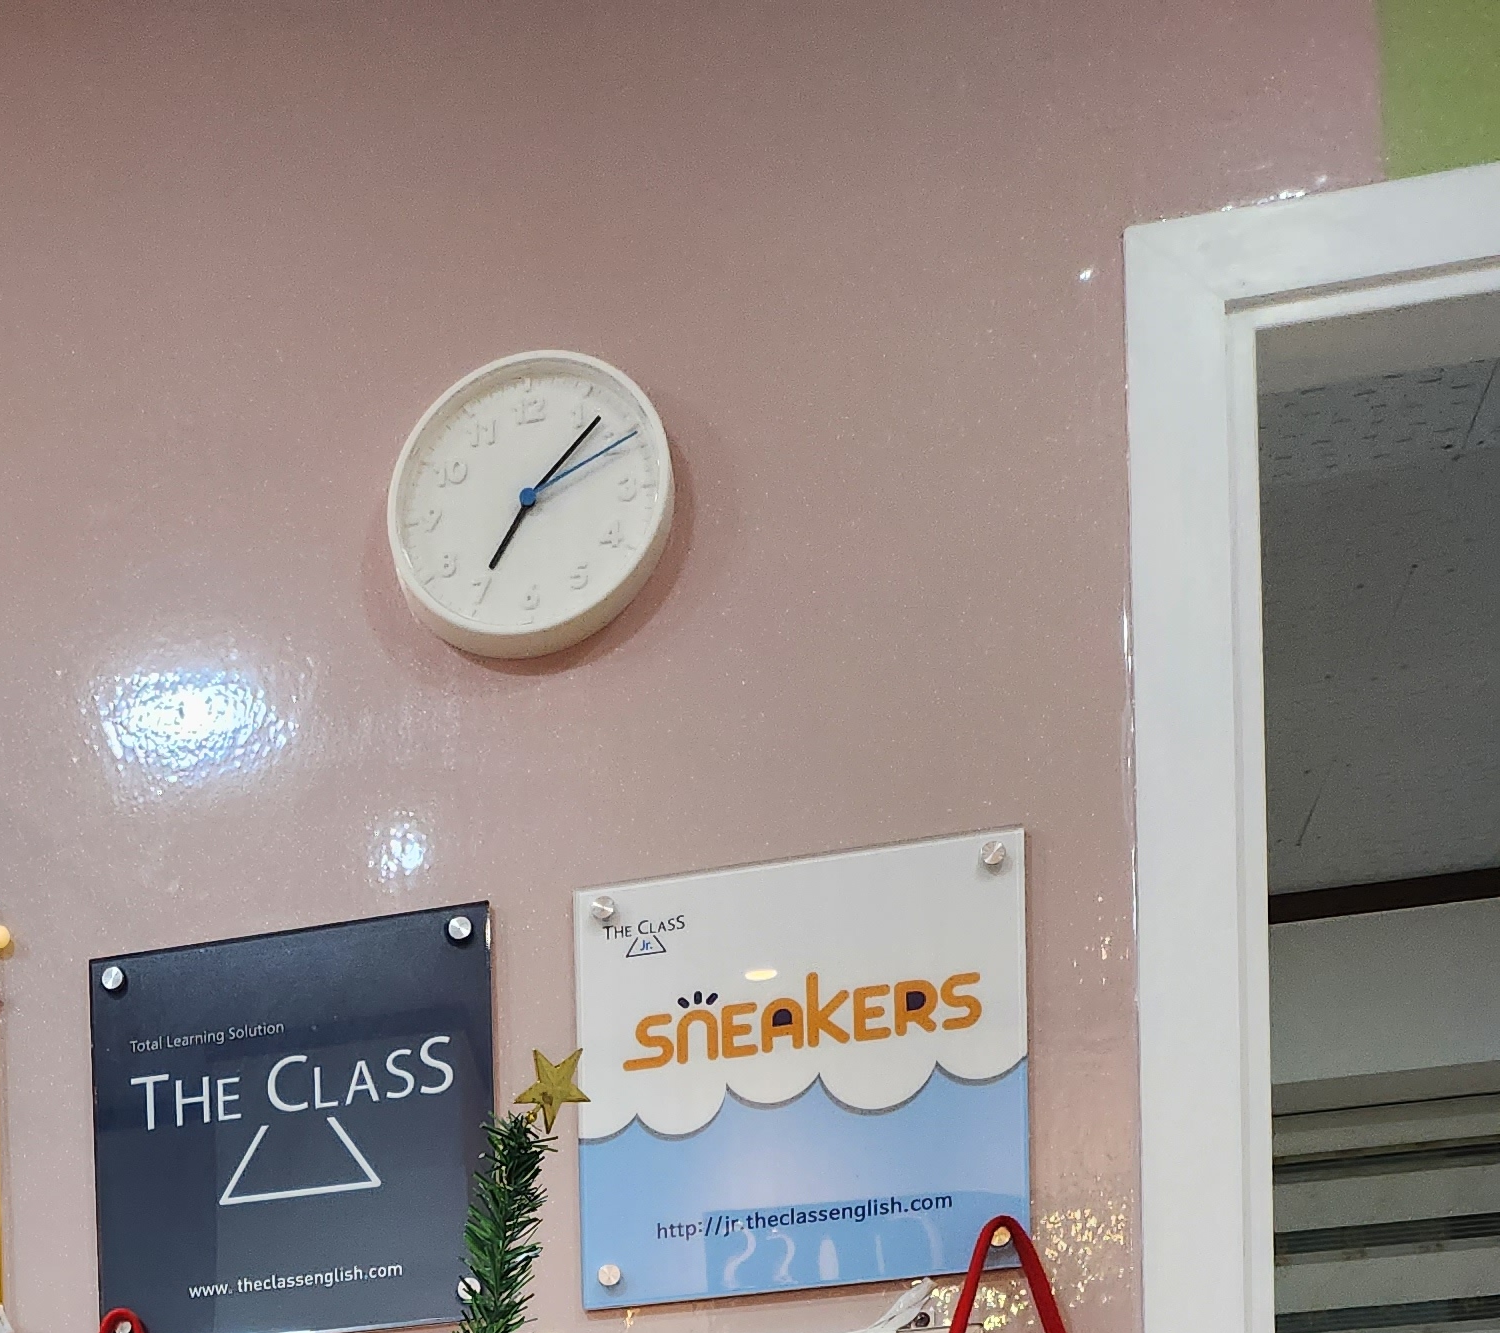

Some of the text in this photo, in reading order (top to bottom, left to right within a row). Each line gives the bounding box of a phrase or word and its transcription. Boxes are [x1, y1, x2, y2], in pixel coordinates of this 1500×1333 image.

[603, 915, 686, 941] THE CLASS
[639, 939, 653, 952] Jr.
[129, 1021, 285, 1054] Total Learning Solution
[130, 1035, 455, 1130] THE CLASS
[656, 1192, 954, 1240] http://jr.theclassenglish.com
